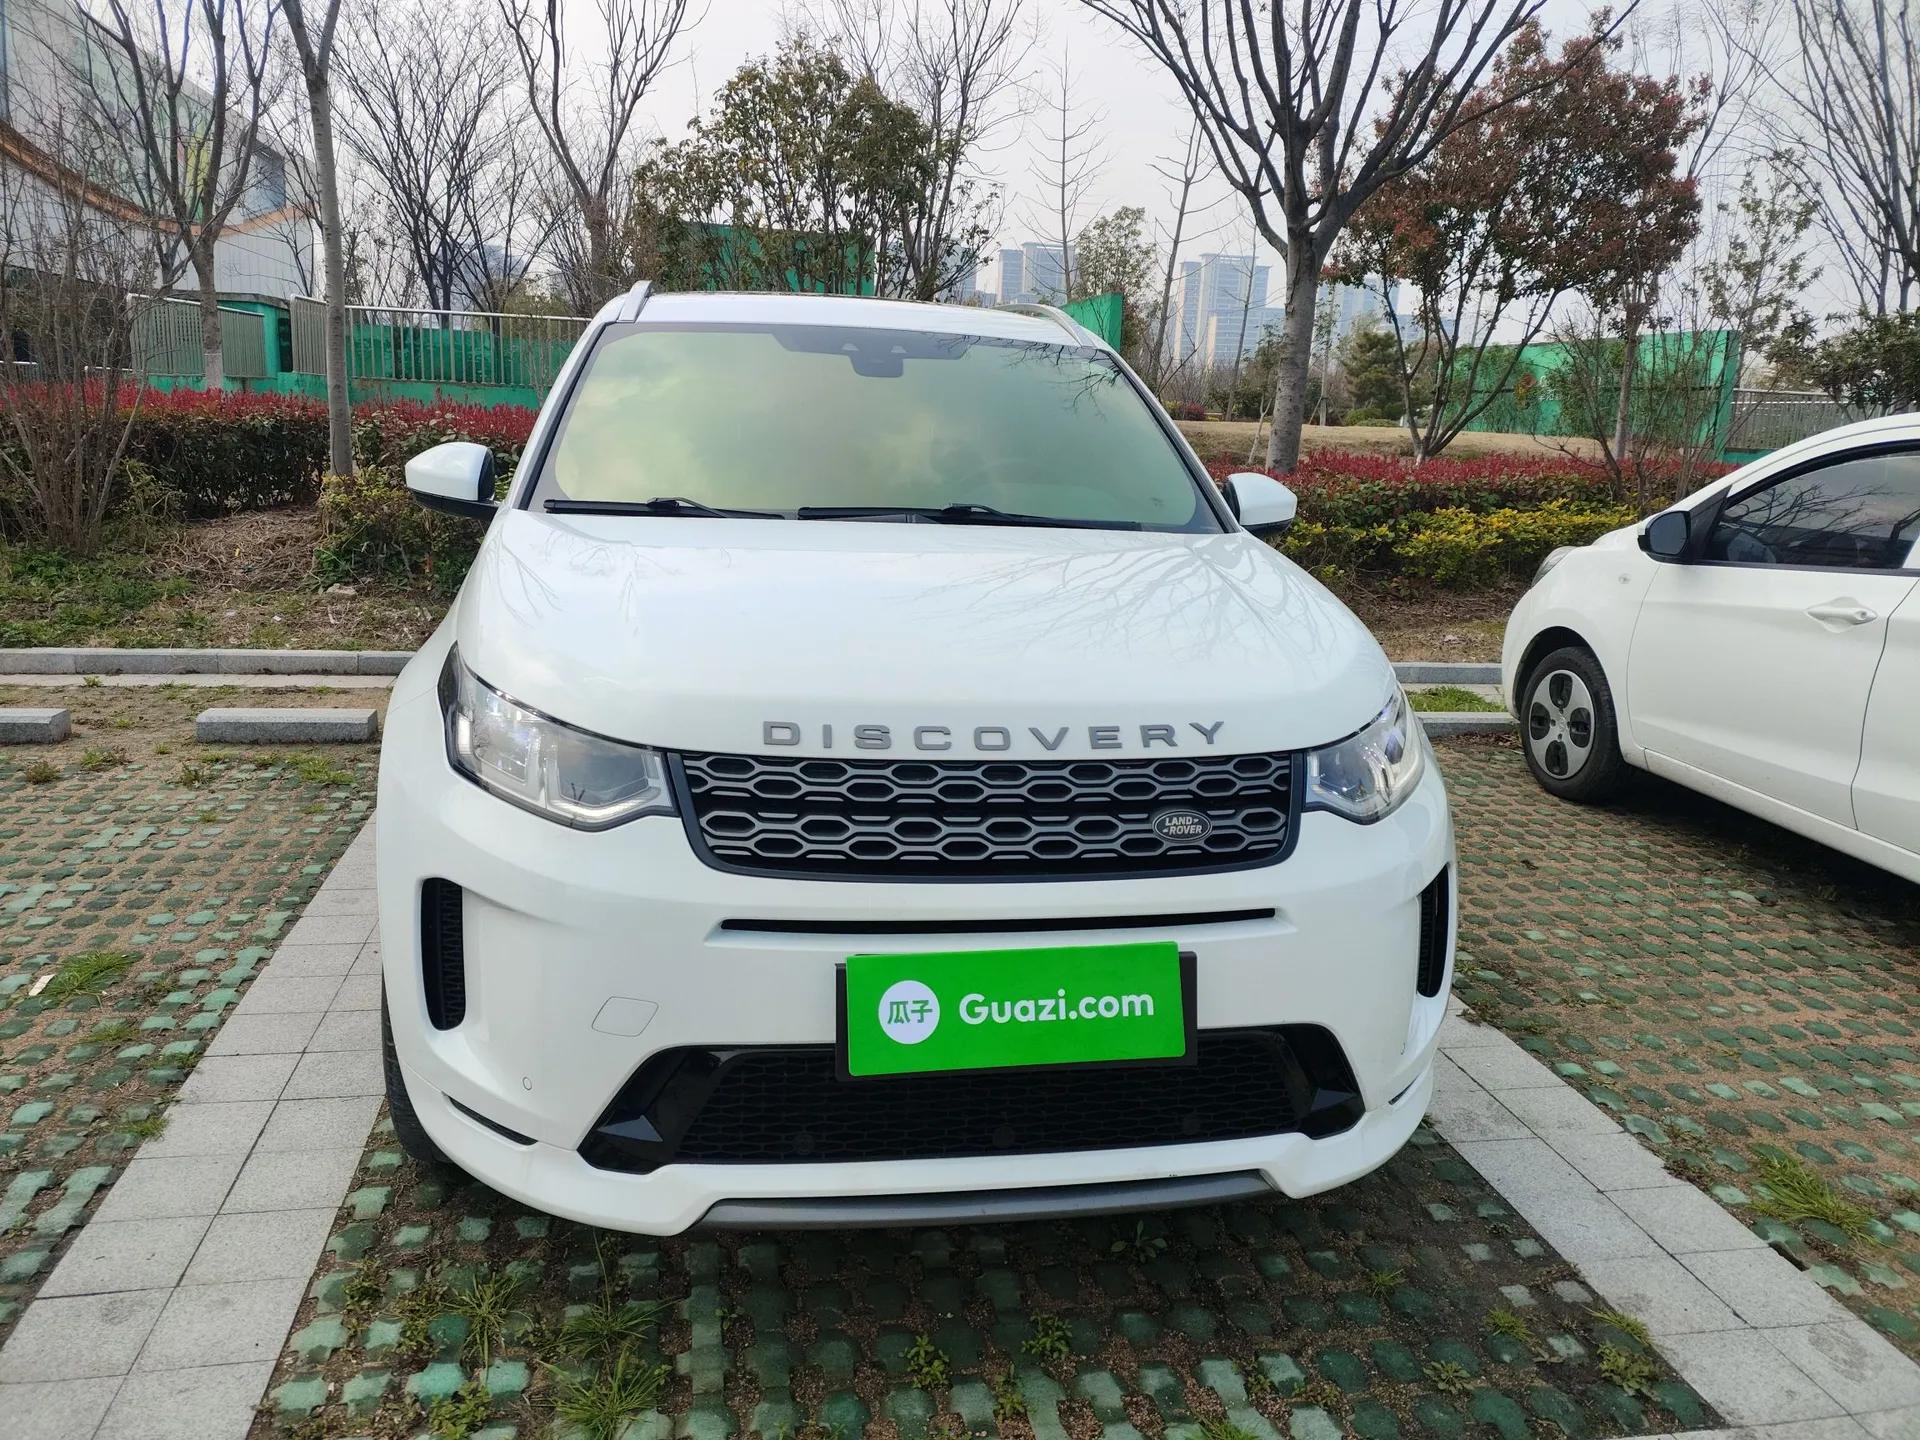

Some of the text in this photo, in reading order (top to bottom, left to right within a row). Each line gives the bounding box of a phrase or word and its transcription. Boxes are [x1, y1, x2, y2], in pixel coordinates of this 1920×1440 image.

[762, 720, 1224, 751] DISCOVERY
[1165, 816, 1193, 826] LAND
[1169, 824, 1203, 835] ROVER
[887, 999, 933, 1025] 瓜子
[958, 988, 1155, 1025] Guazi.com
